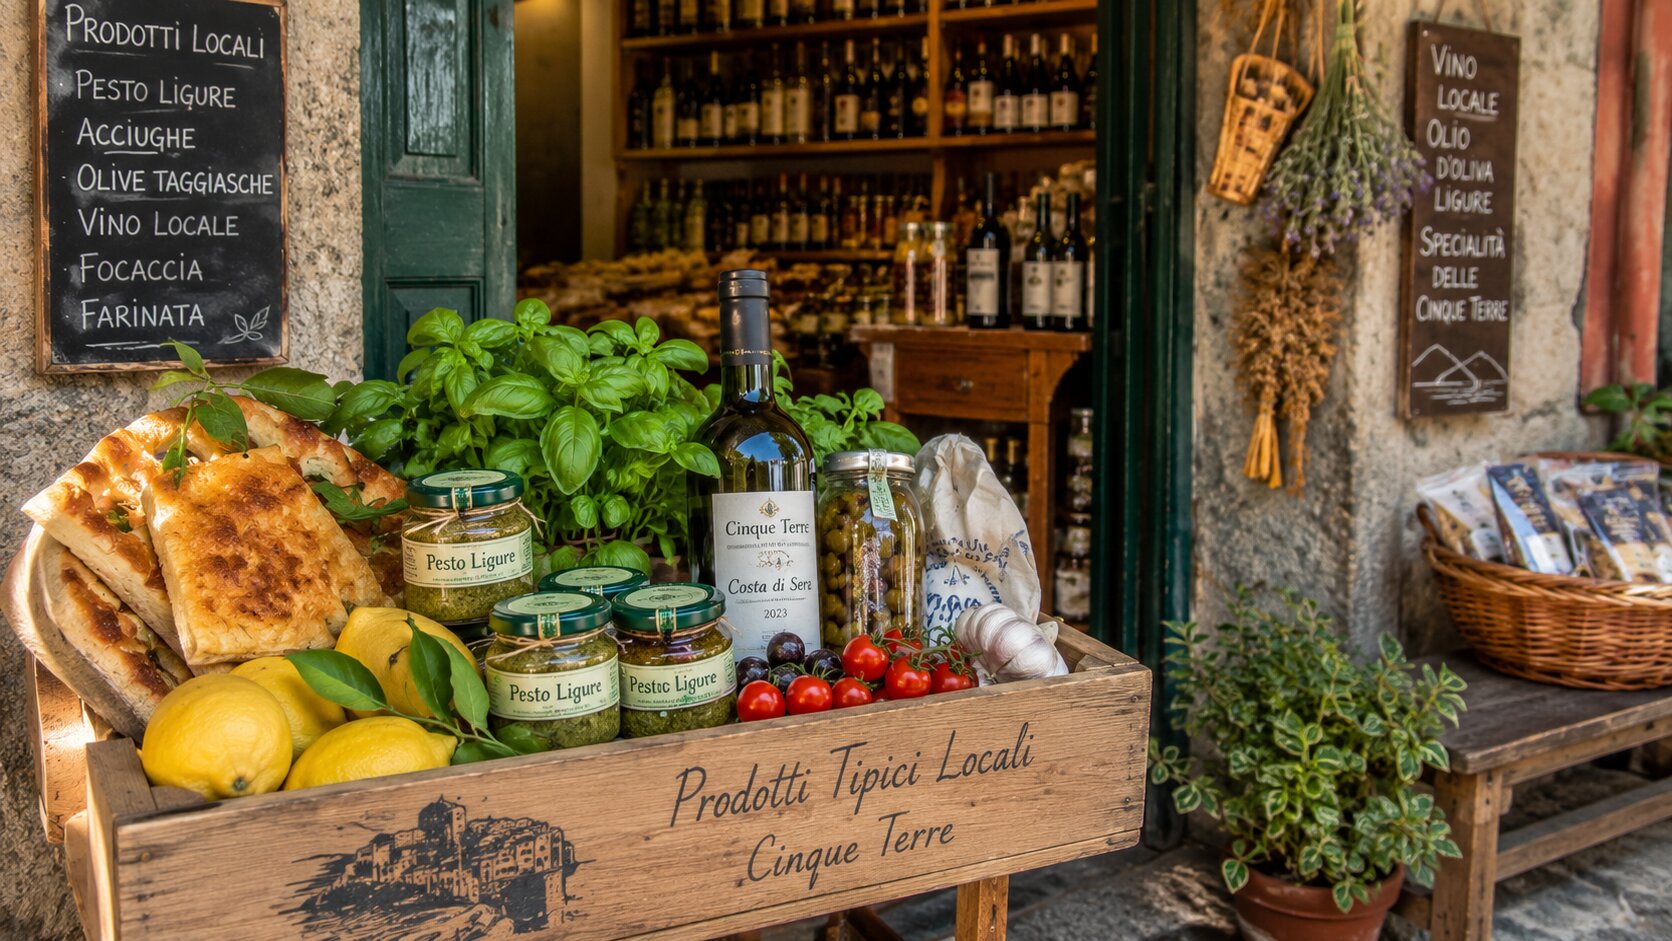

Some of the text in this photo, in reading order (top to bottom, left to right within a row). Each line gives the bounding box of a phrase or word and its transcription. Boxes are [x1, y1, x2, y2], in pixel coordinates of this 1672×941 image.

[65, 4, 265, 59] PRODOTTI LOCALI
[1430, 44, 1478, 80] VINO
[75, 69, 236, 109] PESTO LIGURE
[1437, 84, 1500, 116] LOCALE
[77, 118, 196, 152] ACCIUGHE
[1426, 118, 1471, 150] OLIO
[77, 163, 274, 195] OLIVE TAGGIASCHE
[1436, 154, 1494, 183] D'OLIVA
[1434, 185, 1493, 214] LIGURE
[77, 207, 240, 236] VINO LOCALE
[1419, 225, 1506, 258] SPECIALITÀ
[80, 252, 203, 283] FOCACCIA
[1432, 265, 1479, 289] DELLE
[81, 298, 205, 330] FARINATA
[1416, 294, 1509, 325] CINQUE TERRE
[726, 521, 776, 539] Cinque
[426, 554, 466, 571] Pesto
[470, 552, 516, 572] Ligure
[728, 578, 767, 595] Costa
[773, 578, 785, 592] di
[764, 608, 788, 619] 2023
[509, 684, 551, 702] Pesto
[556, 682, 602, 704] Ligure
[675, 672, 717, 695] Ligure
[670, 721, 1035, 828] Prodotti Tipici Locali
[746, 810, 956, 891] Cinque Terre
